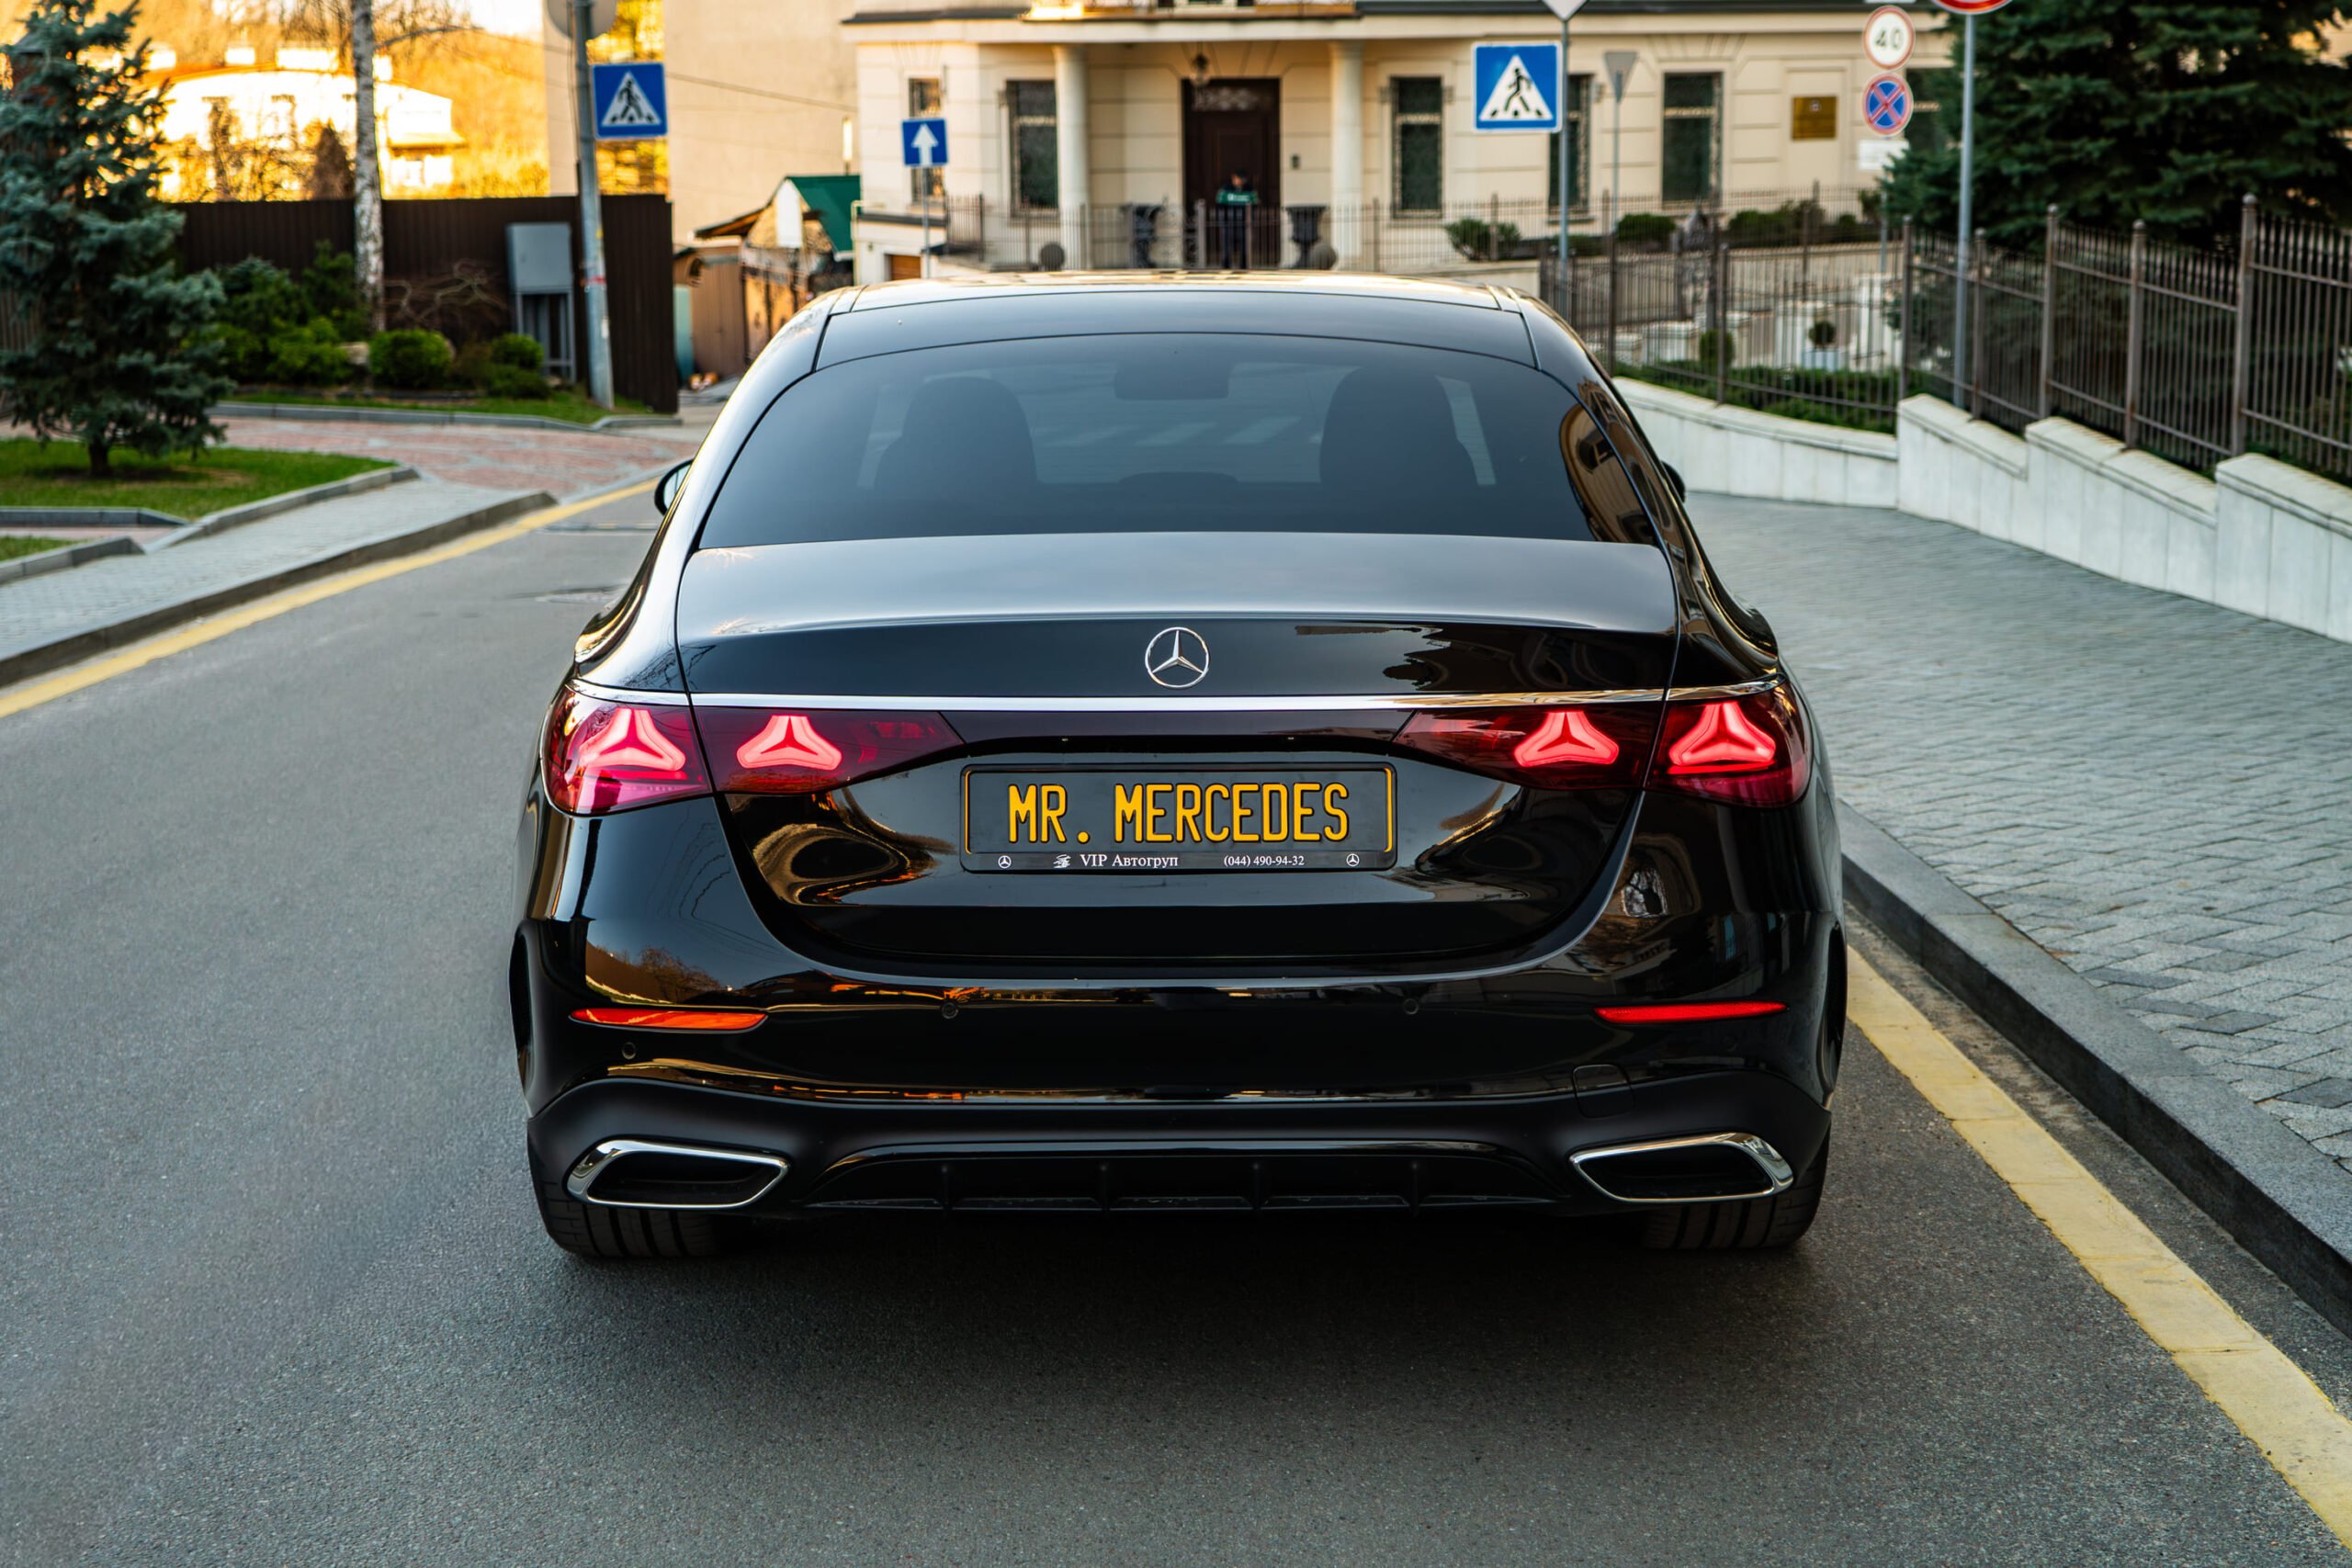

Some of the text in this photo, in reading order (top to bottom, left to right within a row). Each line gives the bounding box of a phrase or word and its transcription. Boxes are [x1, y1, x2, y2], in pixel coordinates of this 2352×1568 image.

[1875, 28, 1902, 50] 40
[1009, 783, 1348, 843] MR. MERCEDES
[1080, 853, 1179, 869] VIP Автогруп
[1224, 854, 1306, 867] (044) 490-94-32
